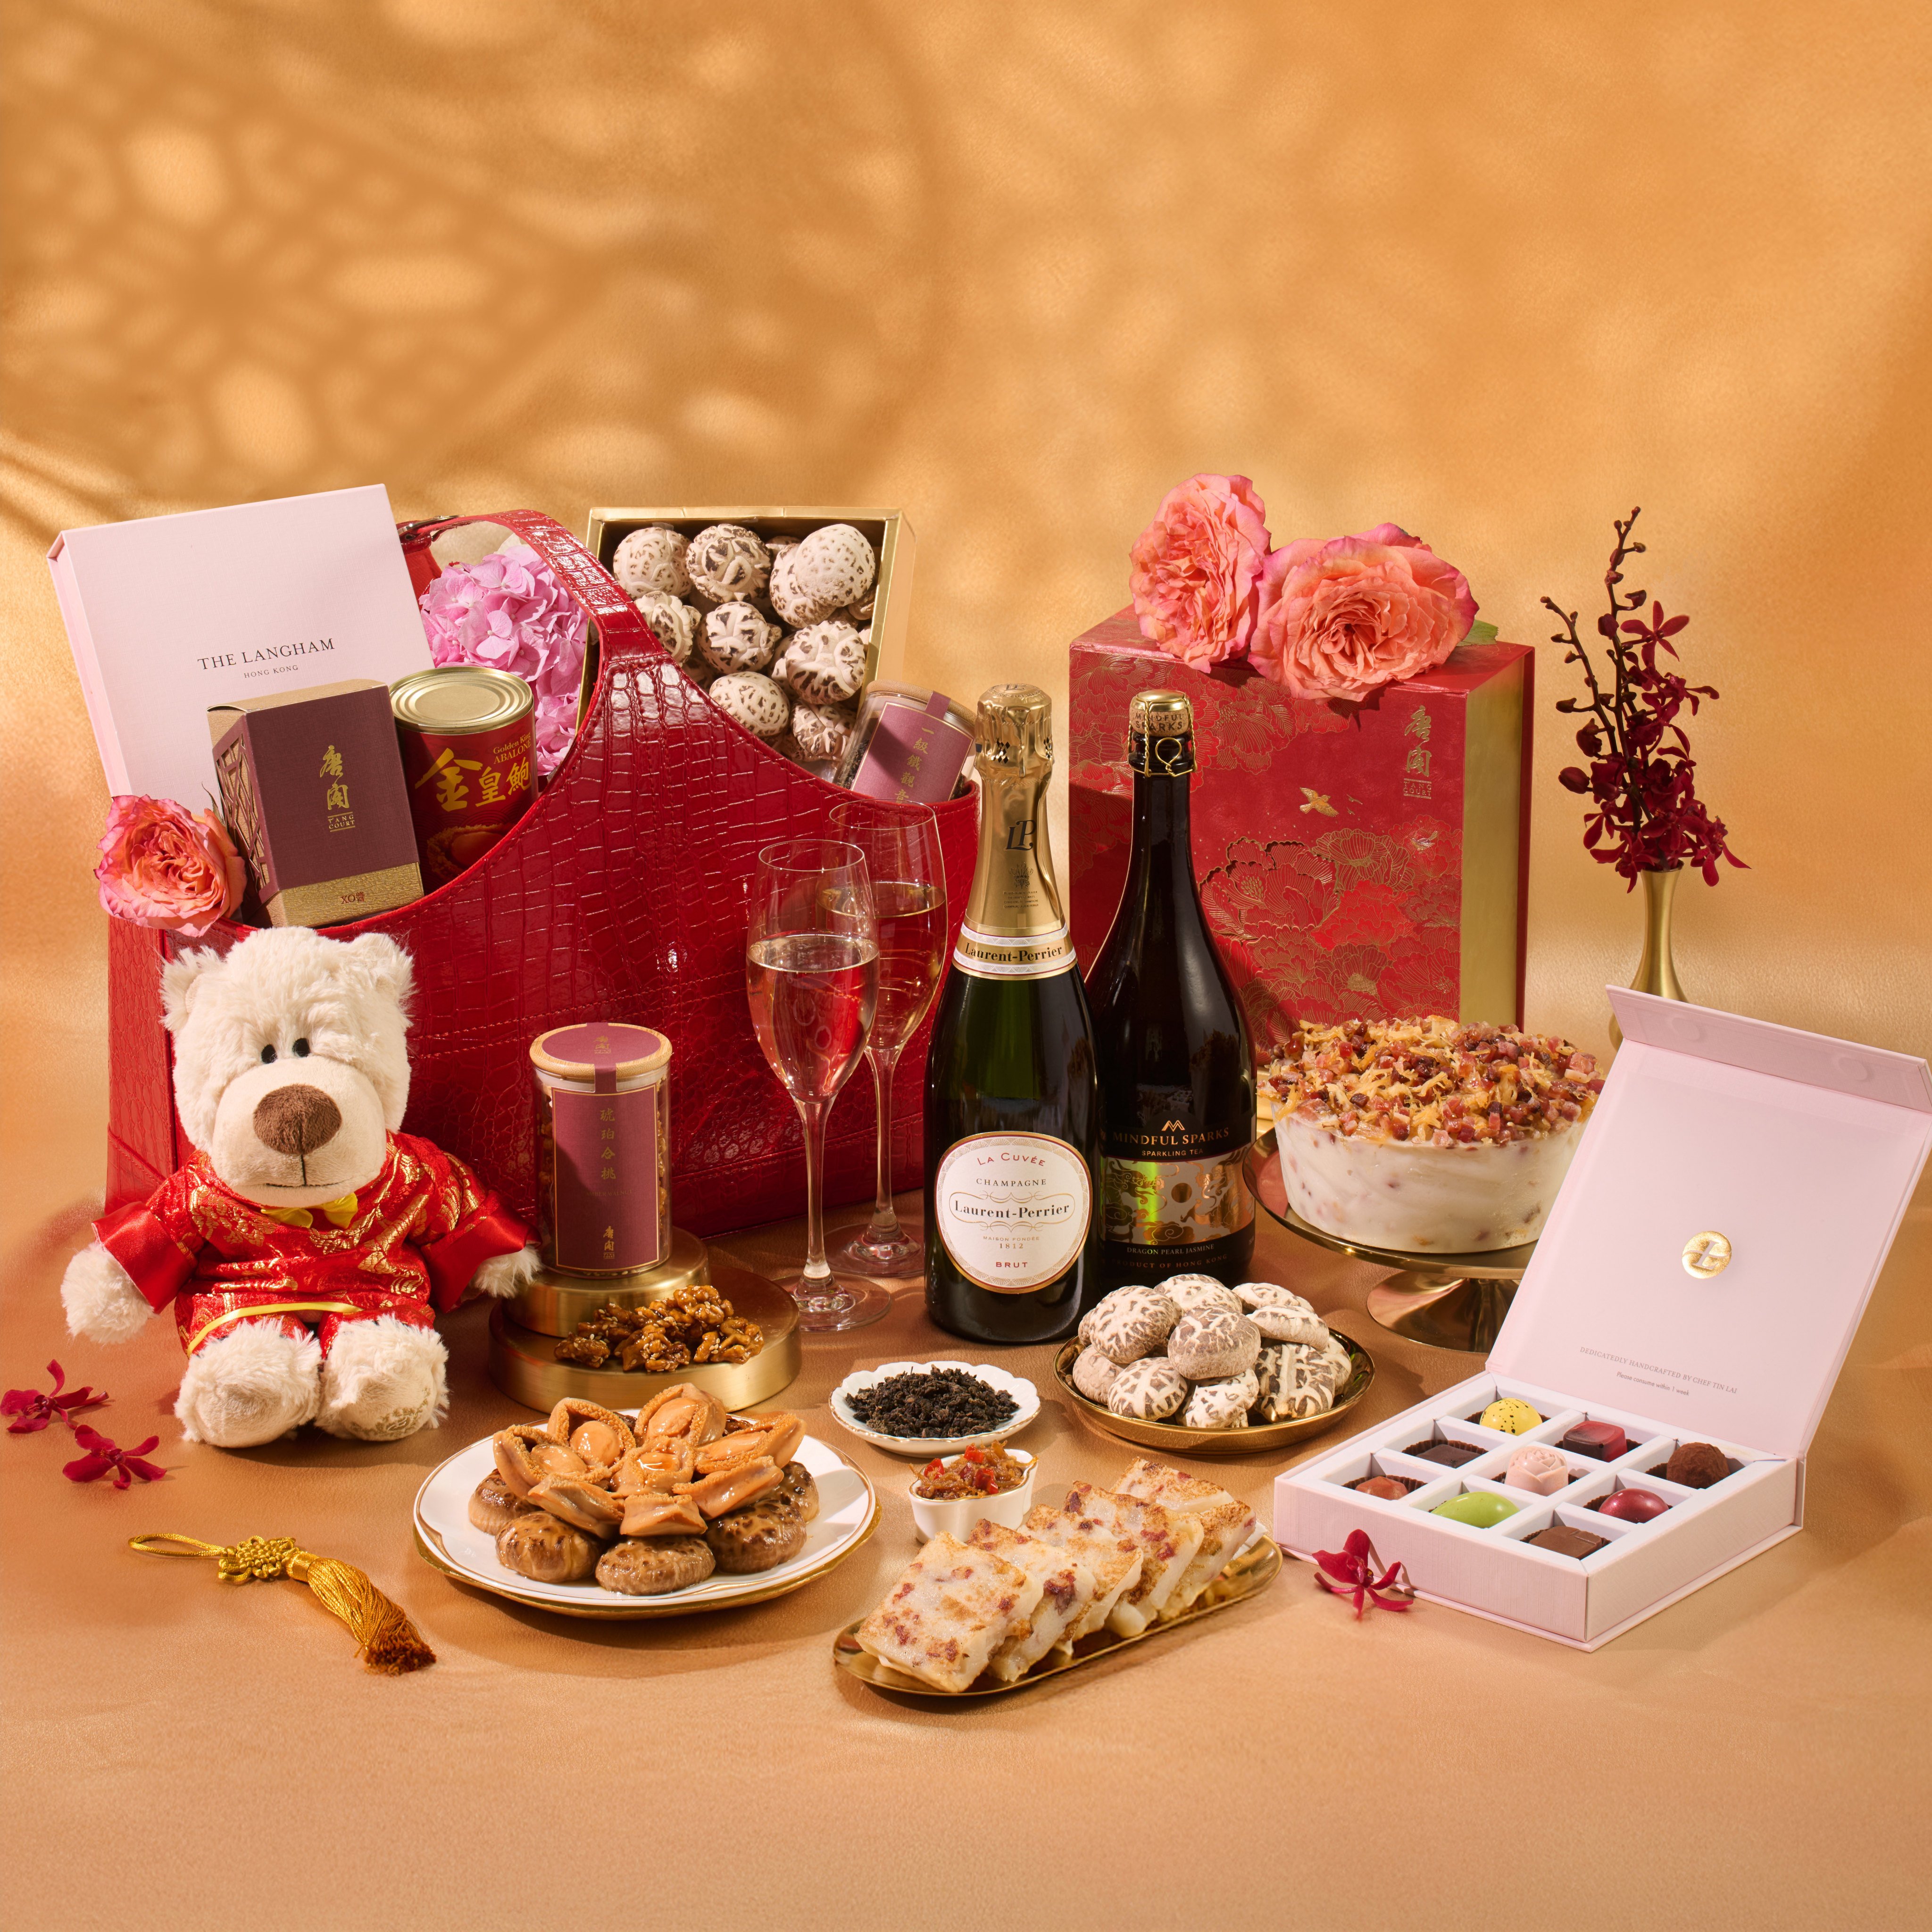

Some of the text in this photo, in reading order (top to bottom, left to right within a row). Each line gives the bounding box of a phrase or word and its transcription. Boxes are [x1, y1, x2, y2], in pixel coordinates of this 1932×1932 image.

[198, 638, 335, 670] THE LANGHAM
[244, 665, 299, 678] HONG KONG
[1135, 713, 1183, 722] MINDFUL
[1136, 721, 1183, 732] SPARKS
[493, 732, 531, 754] Golden King
[494, 739, 532, 764] ABALONE
[415, 748, 532, 812] 金皇鮑
[1404, 781, 1432, 790] T'ANG
[1403, 787, 1432, 796] COURT
[328, 815, 354, 824] T'ANG
[329, 820, 355, 829] COURT
[1006, 820, 1037, 851] LP
[965, 942, 1062, 962] Laurent-Perrier
[1113, 1127, 1229, 1145] MINDFUL SPARKS
[976, 1178, 1046, 1186] CHAMPAGNE
[955, 1200, 1069, 1218] Laurent-Perrier
[1186, 1243, 1215, 1254] JASMINE
[1112, 1259, 1155, 1268] PRODUCT
[1176, 1260, 1202, 1268] HONG
[1206, 1254, 1227, 1264] KONG
[1580, 1347, 1628, 1364] DEDICATEDLY
[1629, 1360, 1681, 1378] HANDCRAFTED
[1692, 1377, 1711, 1386] CHEF
[1713, 1382, 1724, 1391] TIN
[1616, 1371, 1632, 1381] Please
[1633, 1377, 1655, 1387] consume
[1656, 1382, 1670, 1391] within
[1676, 1388, 1690, 1396] week
